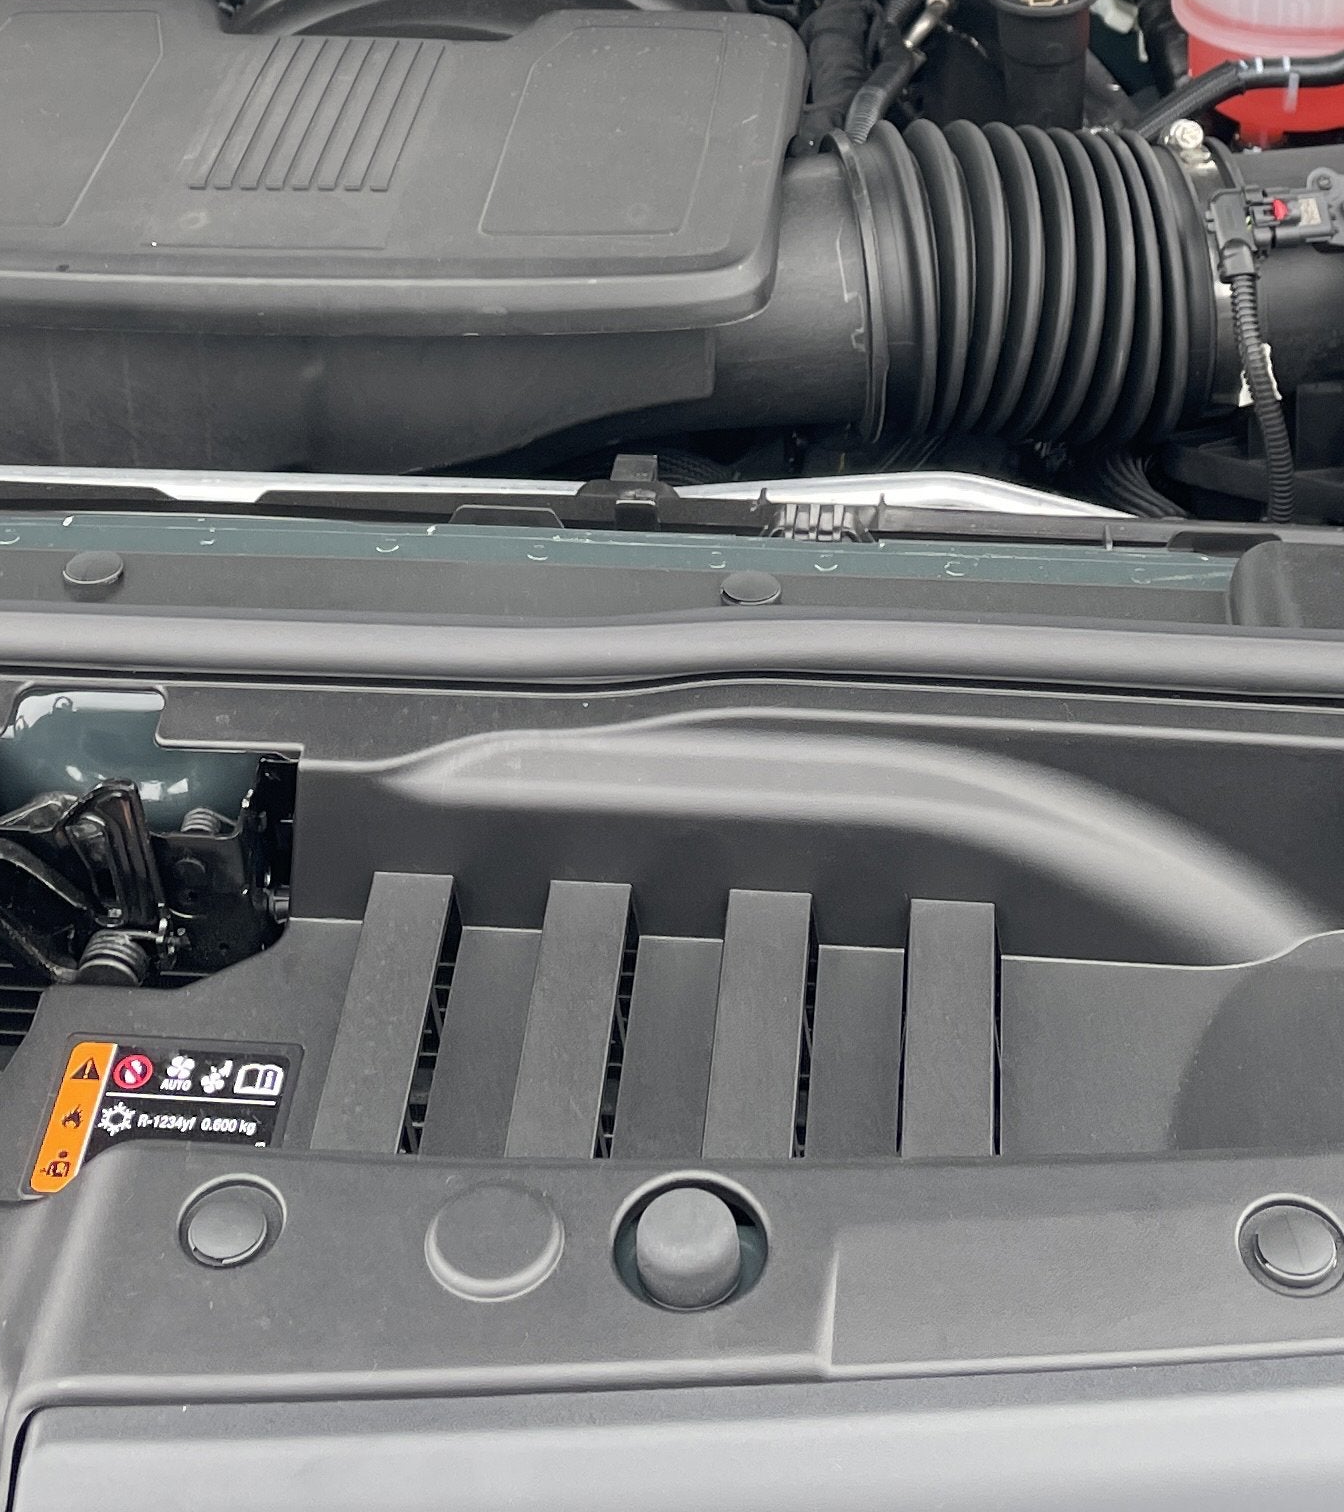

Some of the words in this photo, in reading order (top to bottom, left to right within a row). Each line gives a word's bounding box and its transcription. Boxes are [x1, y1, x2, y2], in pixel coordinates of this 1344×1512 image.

[159, 1078, 192, 1092] AUTO
[137, 1113, 197, 1133] R-1234yf
[200, 1117, 238, 1133] 0.600
[238, 1119, 257, 1136] kg
